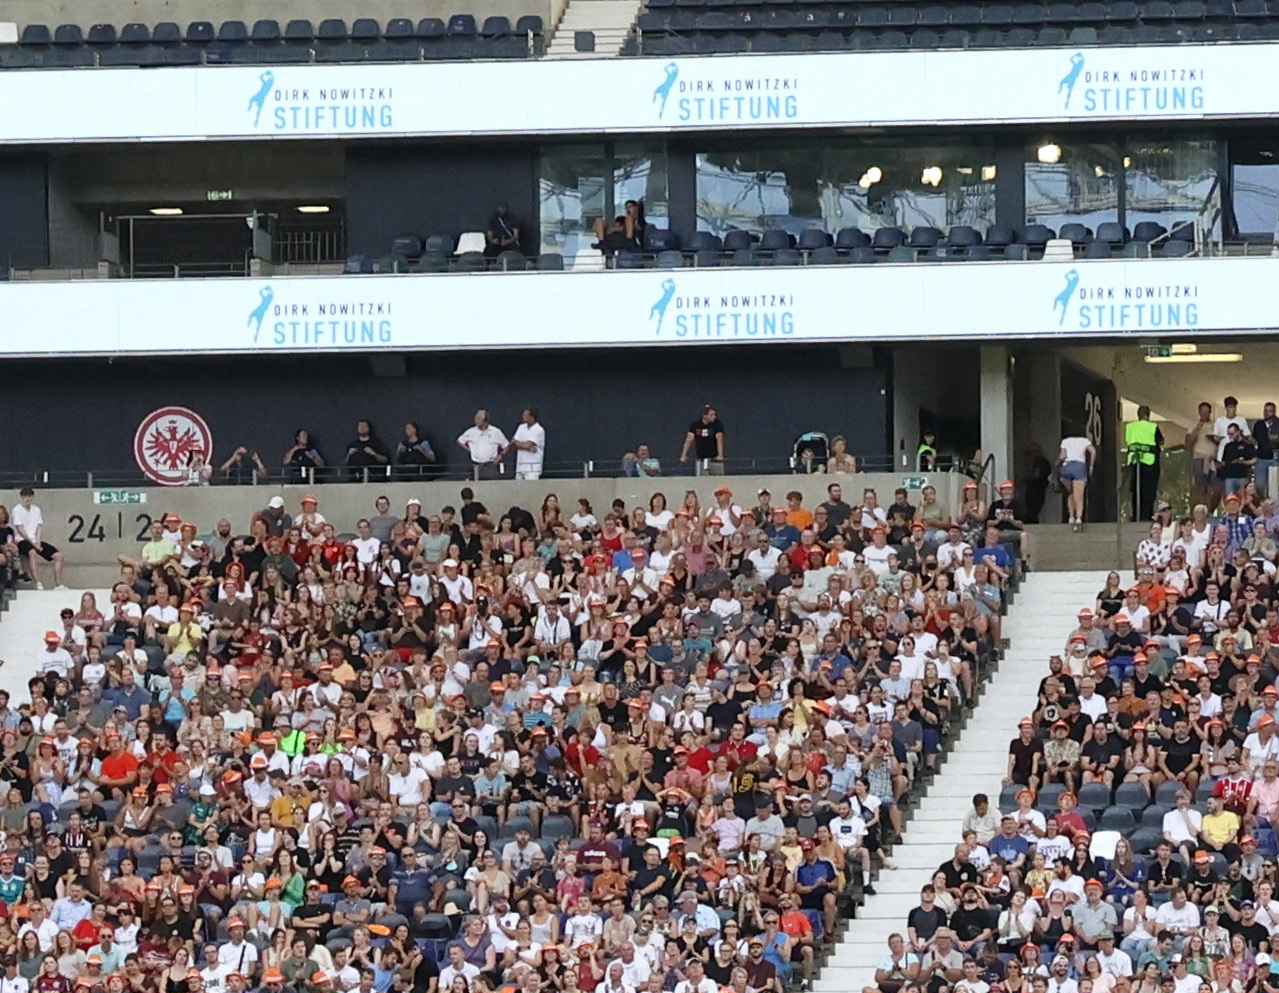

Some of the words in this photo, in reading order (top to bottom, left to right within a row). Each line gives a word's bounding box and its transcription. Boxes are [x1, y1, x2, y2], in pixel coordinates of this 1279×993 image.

[679, 80, 714, 93] DIRK
[724, 78, 797, 92] NOWITZKI
[1084, 70, 1120, 84] DIRK
[1130, 68, 1204, 83] NOWITZKI
[274, 89, 310, 102] DIRK
[319, 87, 393, 101] NOWITZKI
[1084, 85, 1204, 112] STIFTUNG
[273, 104, 393, 130] STIFTUNG
[678, 94, 798, 122] STIFTUNG
[676, 296, 711, 310] DIRK
[720, 294, 794, 308] NOWITZKI
[1079, 287, 1114, 300] DIRK
[1124, 285, 1198, 299] NOWITZKI
[274, 303, 309, 317] DIRK
[318, 302, 392, 316] NOWITZKI
[1079, 302, 1199, 329] STIFTUNG
[273, 319, 392, 345] STIFTUNG
[675, 311, 794, 338] STIFTUNG
[1084, 392, 1102, 446] 26
[68, 513, 106, 543] 24
[135, 513, 152, 542] 2
